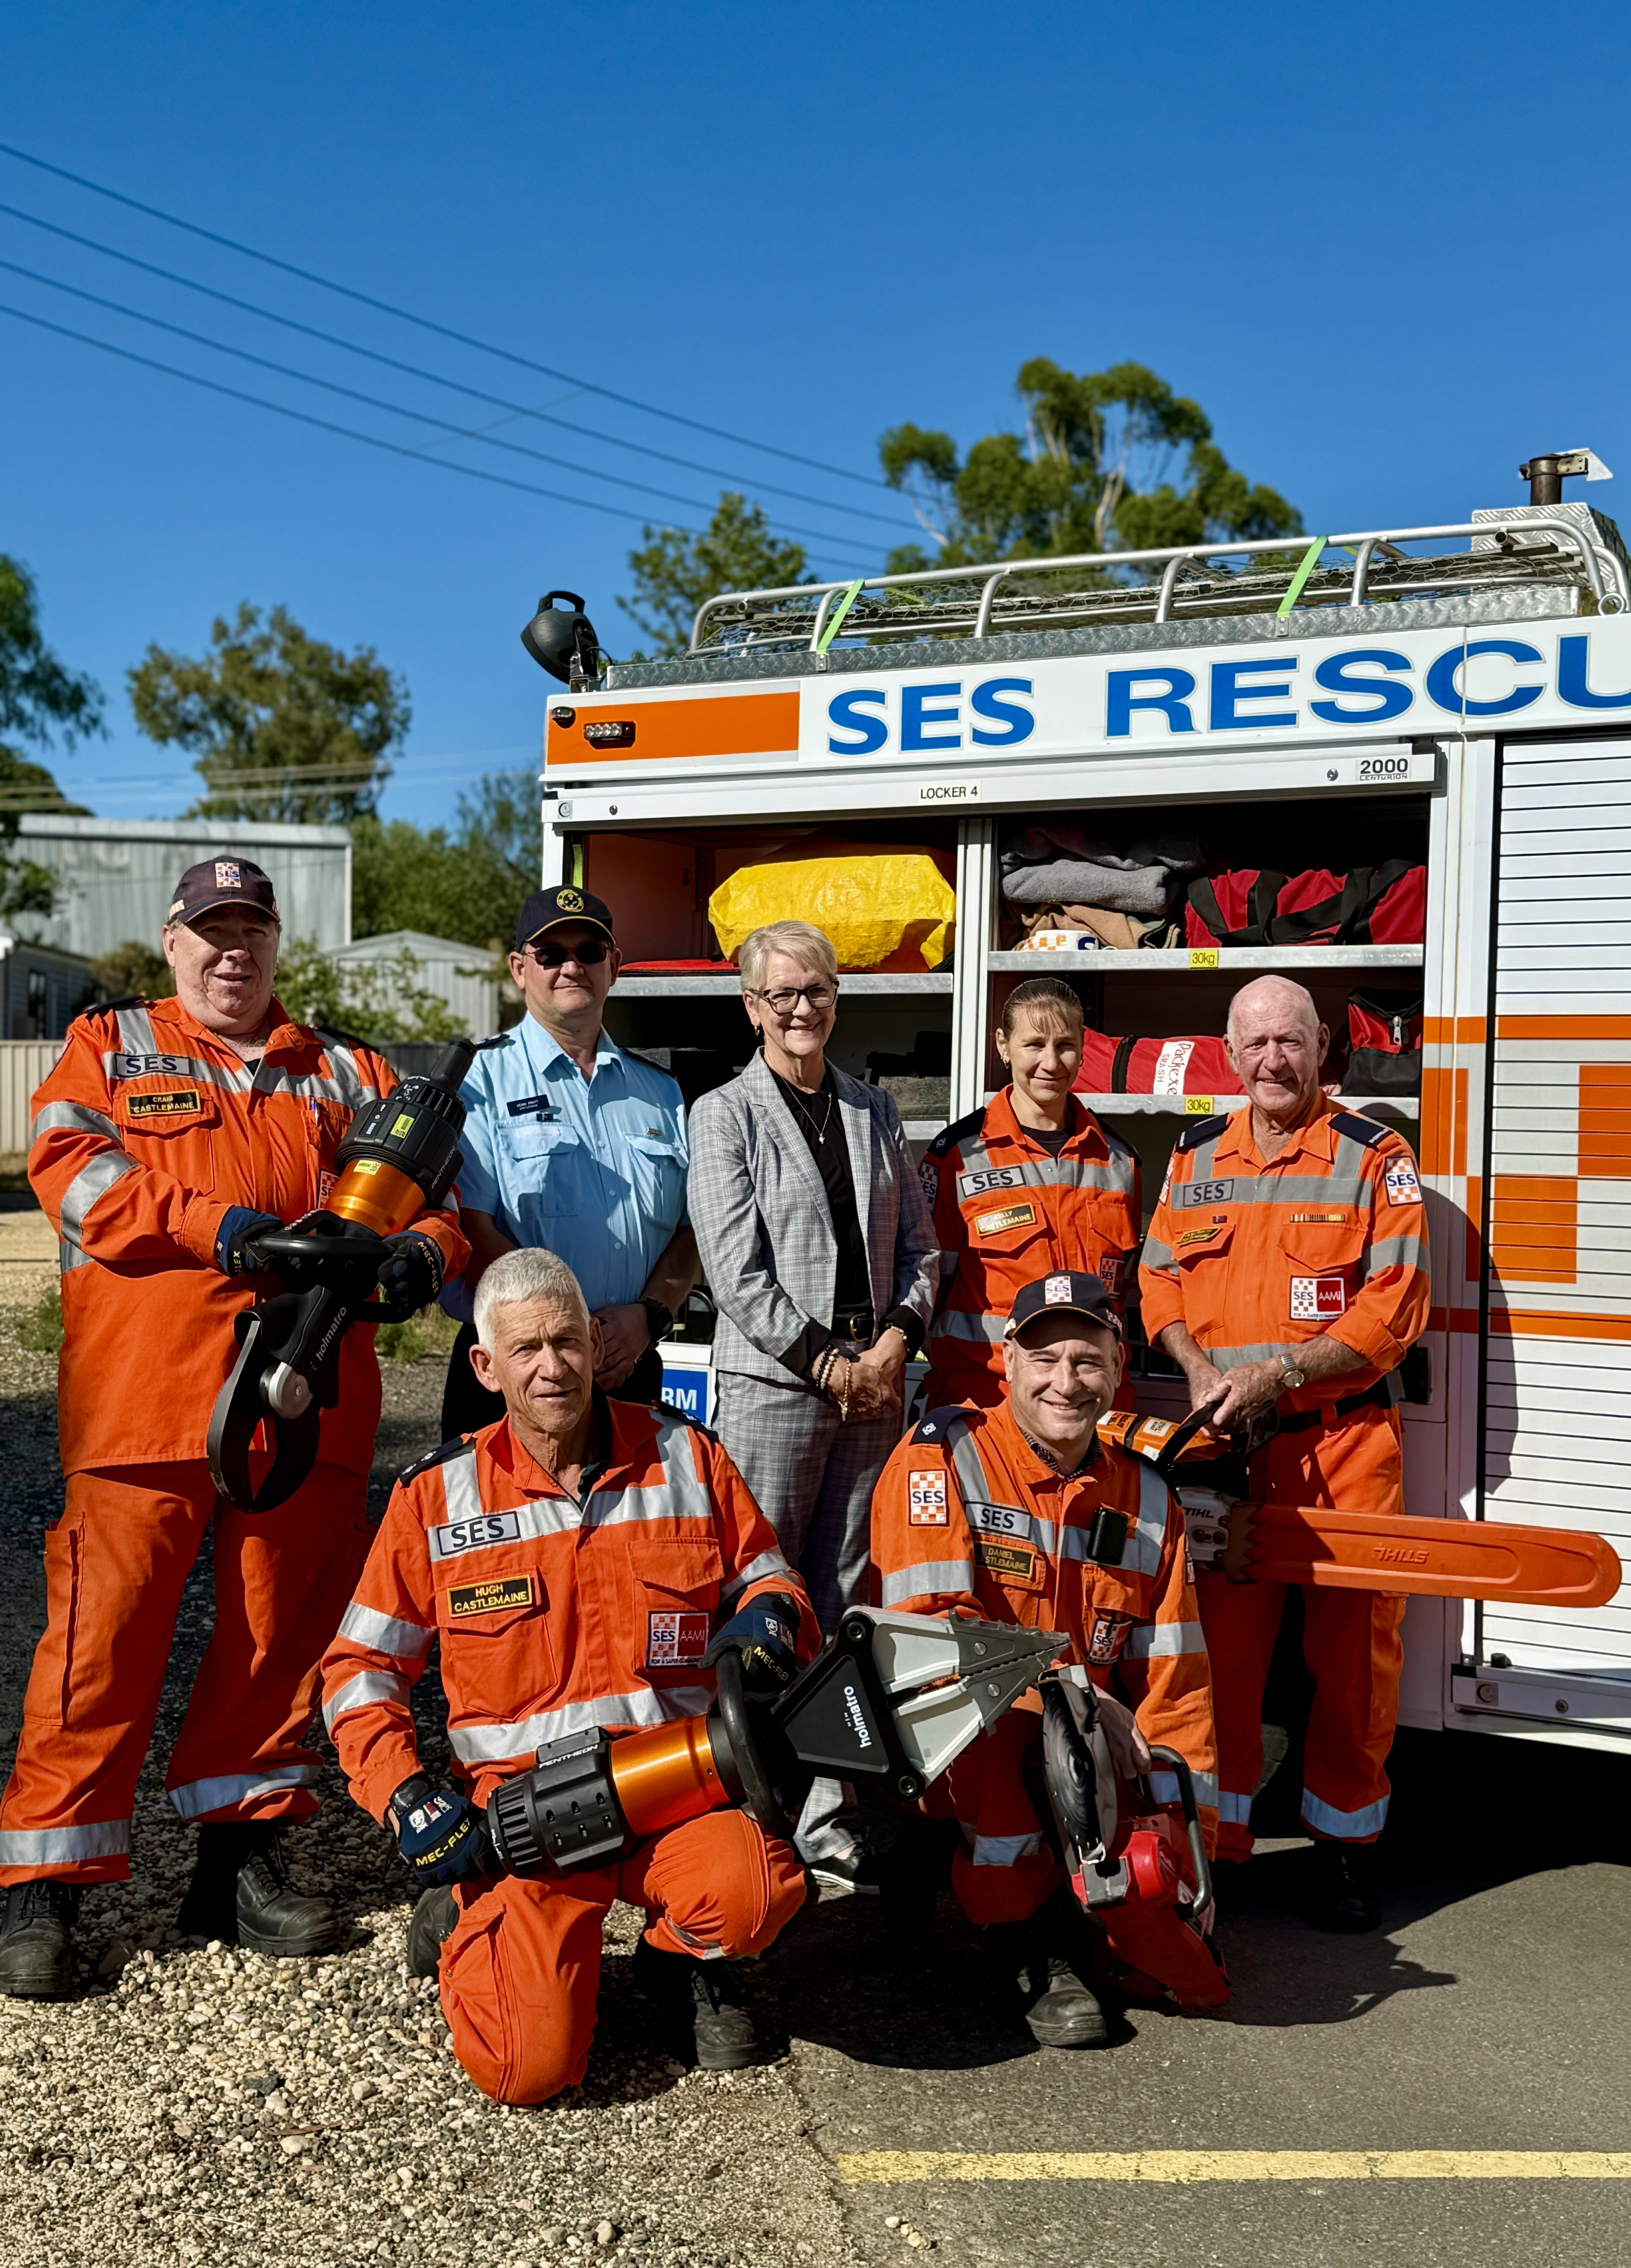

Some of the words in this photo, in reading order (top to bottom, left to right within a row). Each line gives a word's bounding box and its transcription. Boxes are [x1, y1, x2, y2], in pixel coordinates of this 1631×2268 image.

[827, 676, 1036, 756] SES
[1104, 632, 1631, 740] RESCU
[1360, 758, 1408, 774] 2000
[921, 786, 966, 799] LOCKER
[971, 786, 978, 796] 4
[1192, 952, 1215, 966] 30kg
[126, 1056, 177, 1074] SES
[1157, 1053, 1170, 1083] SMASH
[133, 1101, 194, 1113] CASTLEMAINE
[1187, 1099, 1210, 1113] 30kg
[920, 1180, 936, 1195] ES
[972, 1171, 1013, 1190] SES
[1387, 1174, 1416, 1187] SES
[1193, 1183, 1225, 1203] SES
[980, 1214, 1031, 1232] CASTLEMAINE
[417, 1241, 439, 1294] MEC-FLEX
[1102, 1271, 1114, 1280] SES
[1046, 1284, 1070, 1294] SES
[1294, 1291, 1314, 1300] SES
[1318, 1291, 1341, 1301] AAMI
[316, 1307, 346, 1361] holmatro
[912, 1490, 944, 1504] SES
[980, 1508, 1015, 1529] SES
[1182, 1507, 1214, 1518] TIHL
[451, 1517, 505, 1548] SES
[985, 1556, 1027, 1571] STLEMAINE
[475, 1583, 503, 1598] HUGH
[454, 1591, 527, 1612] CASTLEMAINE
[652, 1630, 675, 1642] SES
[679, 1629, 705, 1642] AAMI
[754, 1646, 789, 1681] MEC-FLE
[844, 1686, 872, 1749] holmatro
[539, 1744, 598, 1769] PENTHEON
[416, 1817, 471, 1867] MEC-FLEX
